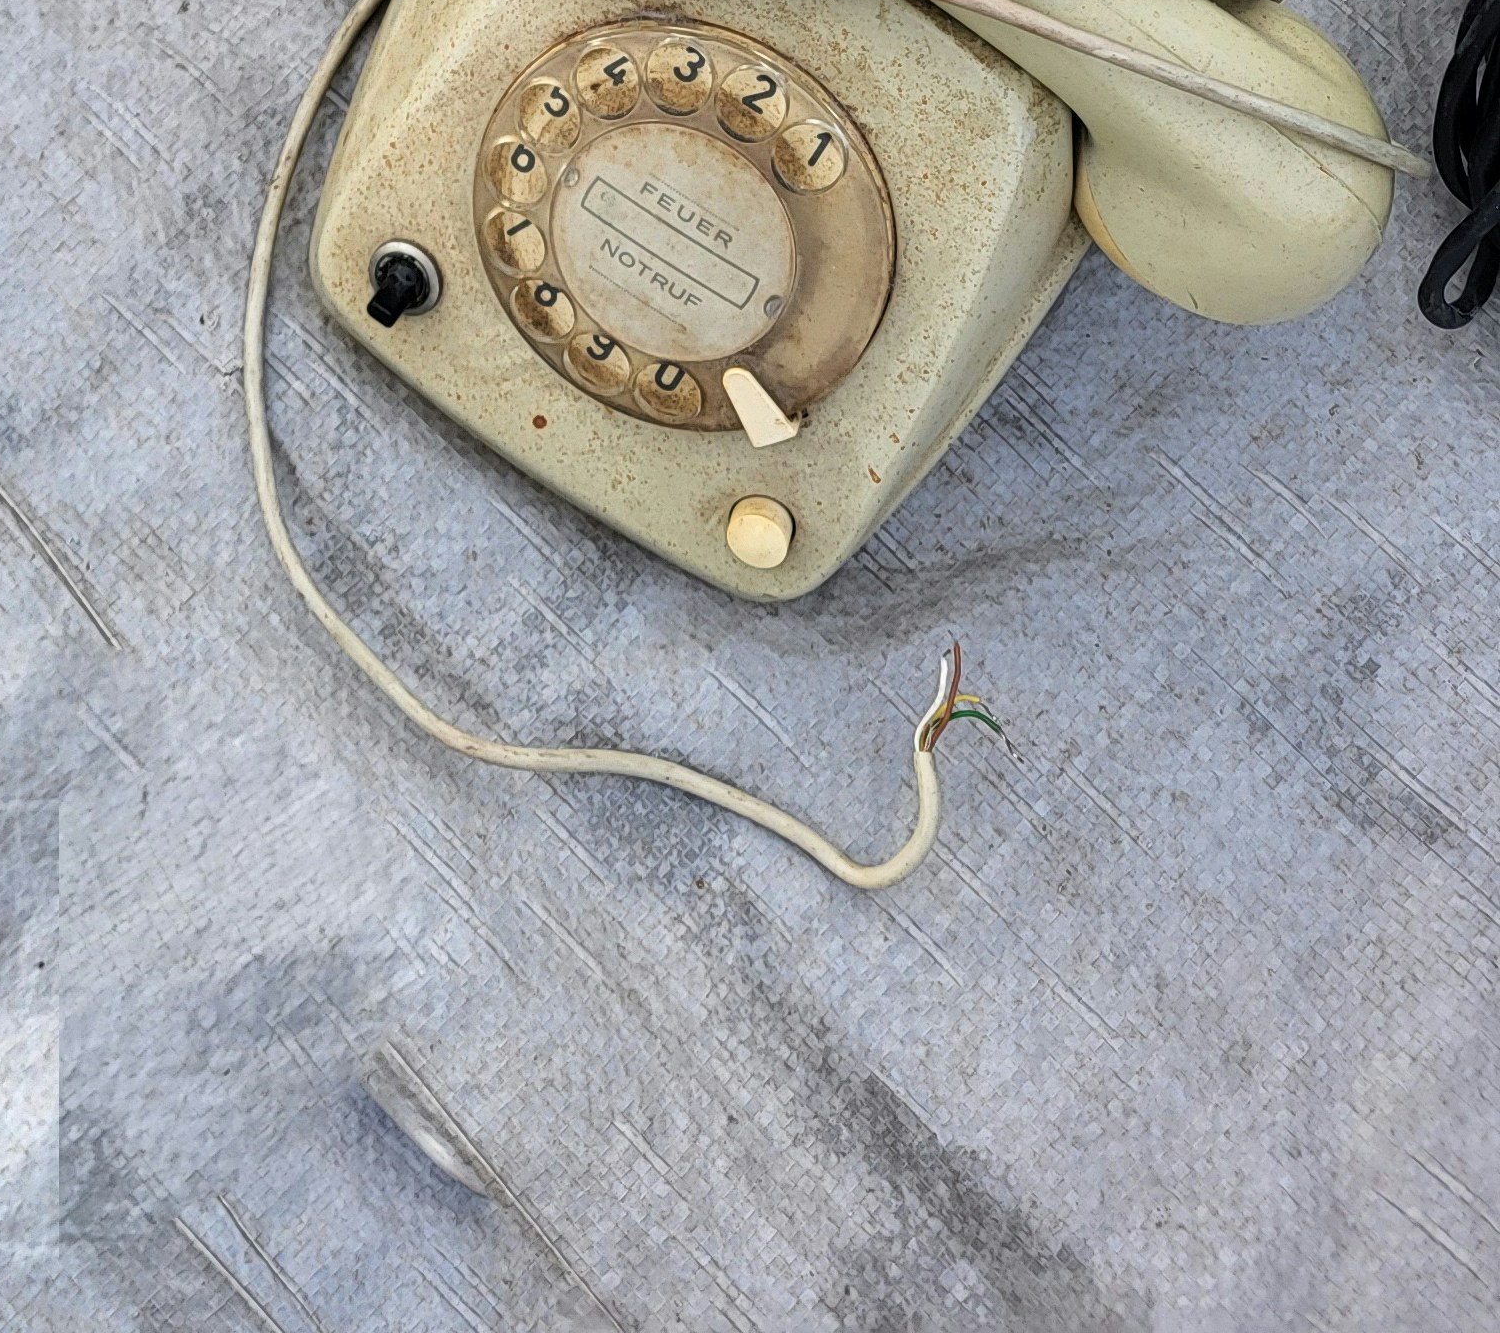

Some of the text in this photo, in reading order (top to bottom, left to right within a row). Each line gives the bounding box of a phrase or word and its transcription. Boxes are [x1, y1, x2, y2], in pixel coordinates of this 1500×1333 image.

[603, 56, 629, 86] 4
[673, 47, 705, 82] 3
[741, 75, 777, 114] 2
[807, 132, 832, 166] 1
[640, 181, 733, 249] FEUER
[600, 238, 703, 306] NOTRUF
[586, 335, 615, 361] 9
